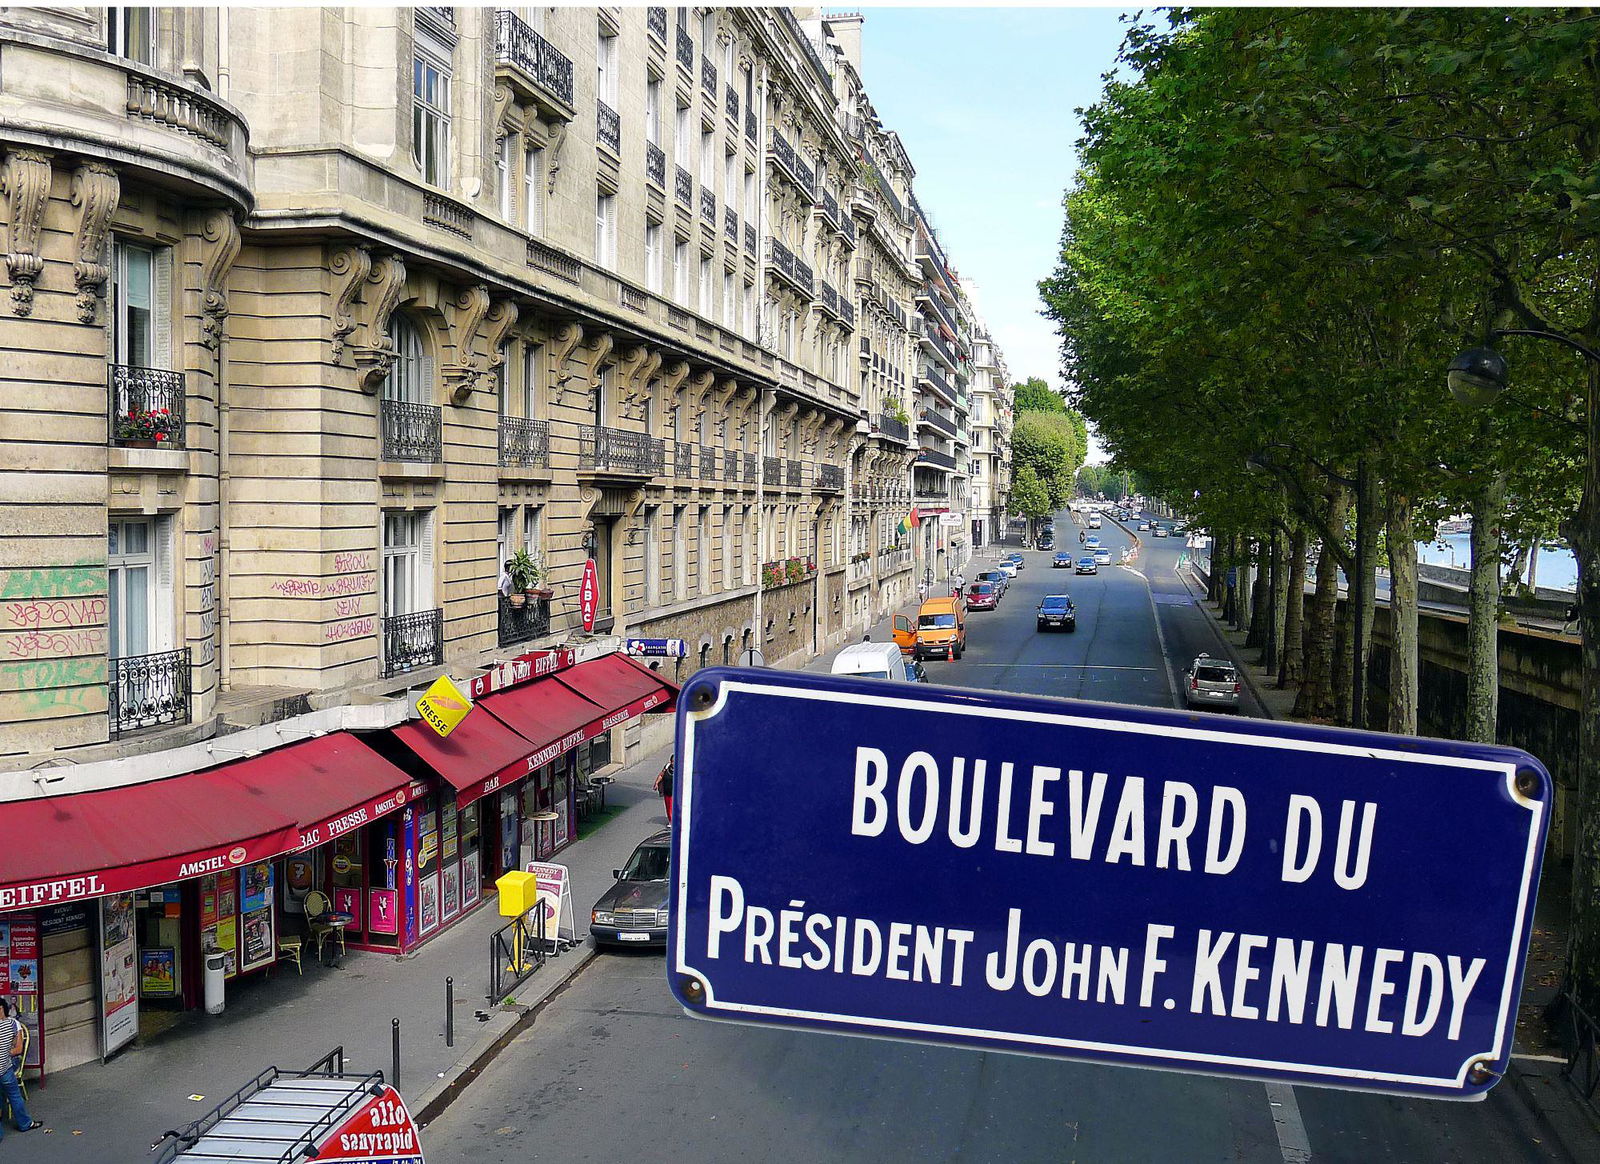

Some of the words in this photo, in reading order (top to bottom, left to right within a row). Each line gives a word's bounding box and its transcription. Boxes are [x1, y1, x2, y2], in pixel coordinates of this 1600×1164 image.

[584, 569, 592, 622] TABAC
[420, 700, 448, 732] PRESSE
[483, 776, 500, 793] BAR
[527, 741, 562, 770] KENNEDY
[562, 729, 586, 751] EIFFEL
[602, 709, 630, 730] BRASSERIE
[327, 808, 368, 837] PRESSE
[374, 799, 396, 816] AMSTEL
[851, 746, 1248, 875] BOULEVARD
[1281, 794, 1378, 891] DU
[0, 875, 105, 908] EIFFEL
[178, 856, 224, 877] AMSTEL
[707, 874, 975, 988] PRÉSIDENT
[986, 907, 1129, 1005] JOHN
[1139, 923, 1176, 1010] F.
[1191, 928, 1487, 1041] KENNEDY
[370, 1101, 406, 1127] allo
[340, 1128, 413, 1155] sanyrapid
